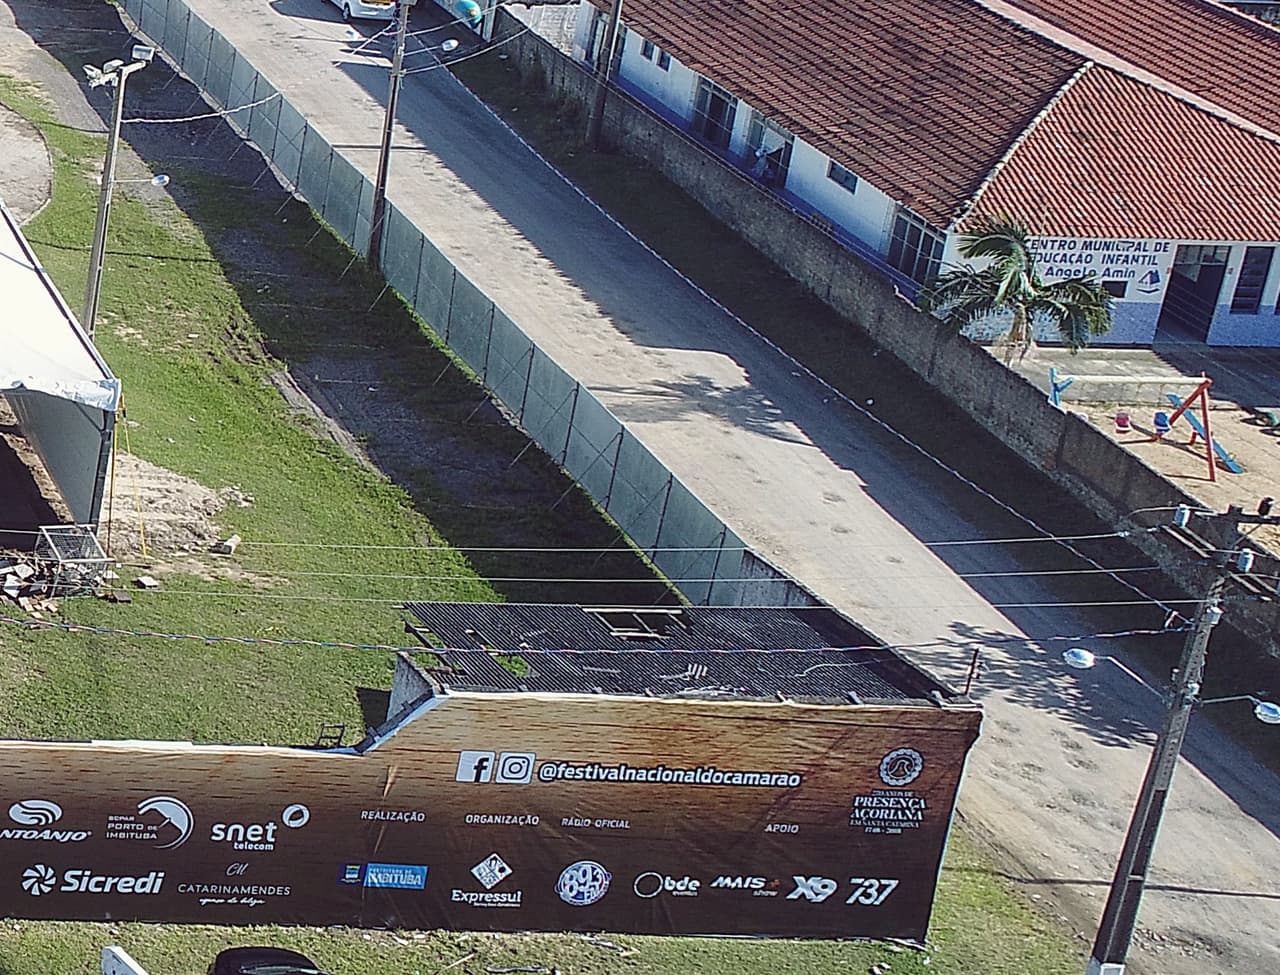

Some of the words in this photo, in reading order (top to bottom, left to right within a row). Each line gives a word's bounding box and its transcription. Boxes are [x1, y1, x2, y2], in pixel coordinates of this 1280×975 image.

[1154, 242, 1170, 252] DE
[1102, 254, 1158, 265] INFANTIL
[1102, 267, 1136, 278] Amin
[539, 762, 801, 788] @festivalnacionaldocamarao
[854, 797, 926, 811] PRESENÇA
[360, 810, 426, 823] REALIZAÇÃO
[465, 813, 540, 826] ORGANIZAÇÃO
[561, 816, 591, 828] RÁDIO
[594, 818, 630, 829] OFICIAL
[107, 823, 144, 831] PORTO
[211, 822, 278, 842] snet
[765, 824, 799, 834] APOIO
[233, 842, 274, 851] telecom
[60, 870, 165, 894] Sicredi
[664, 876, 701, 891] bde
[710, 876, 768, 889] MAIS
[786, 876, 838, 903] X9
[846, 878, 900, 905] 737
[452, 890, 522, 903] Expressul
